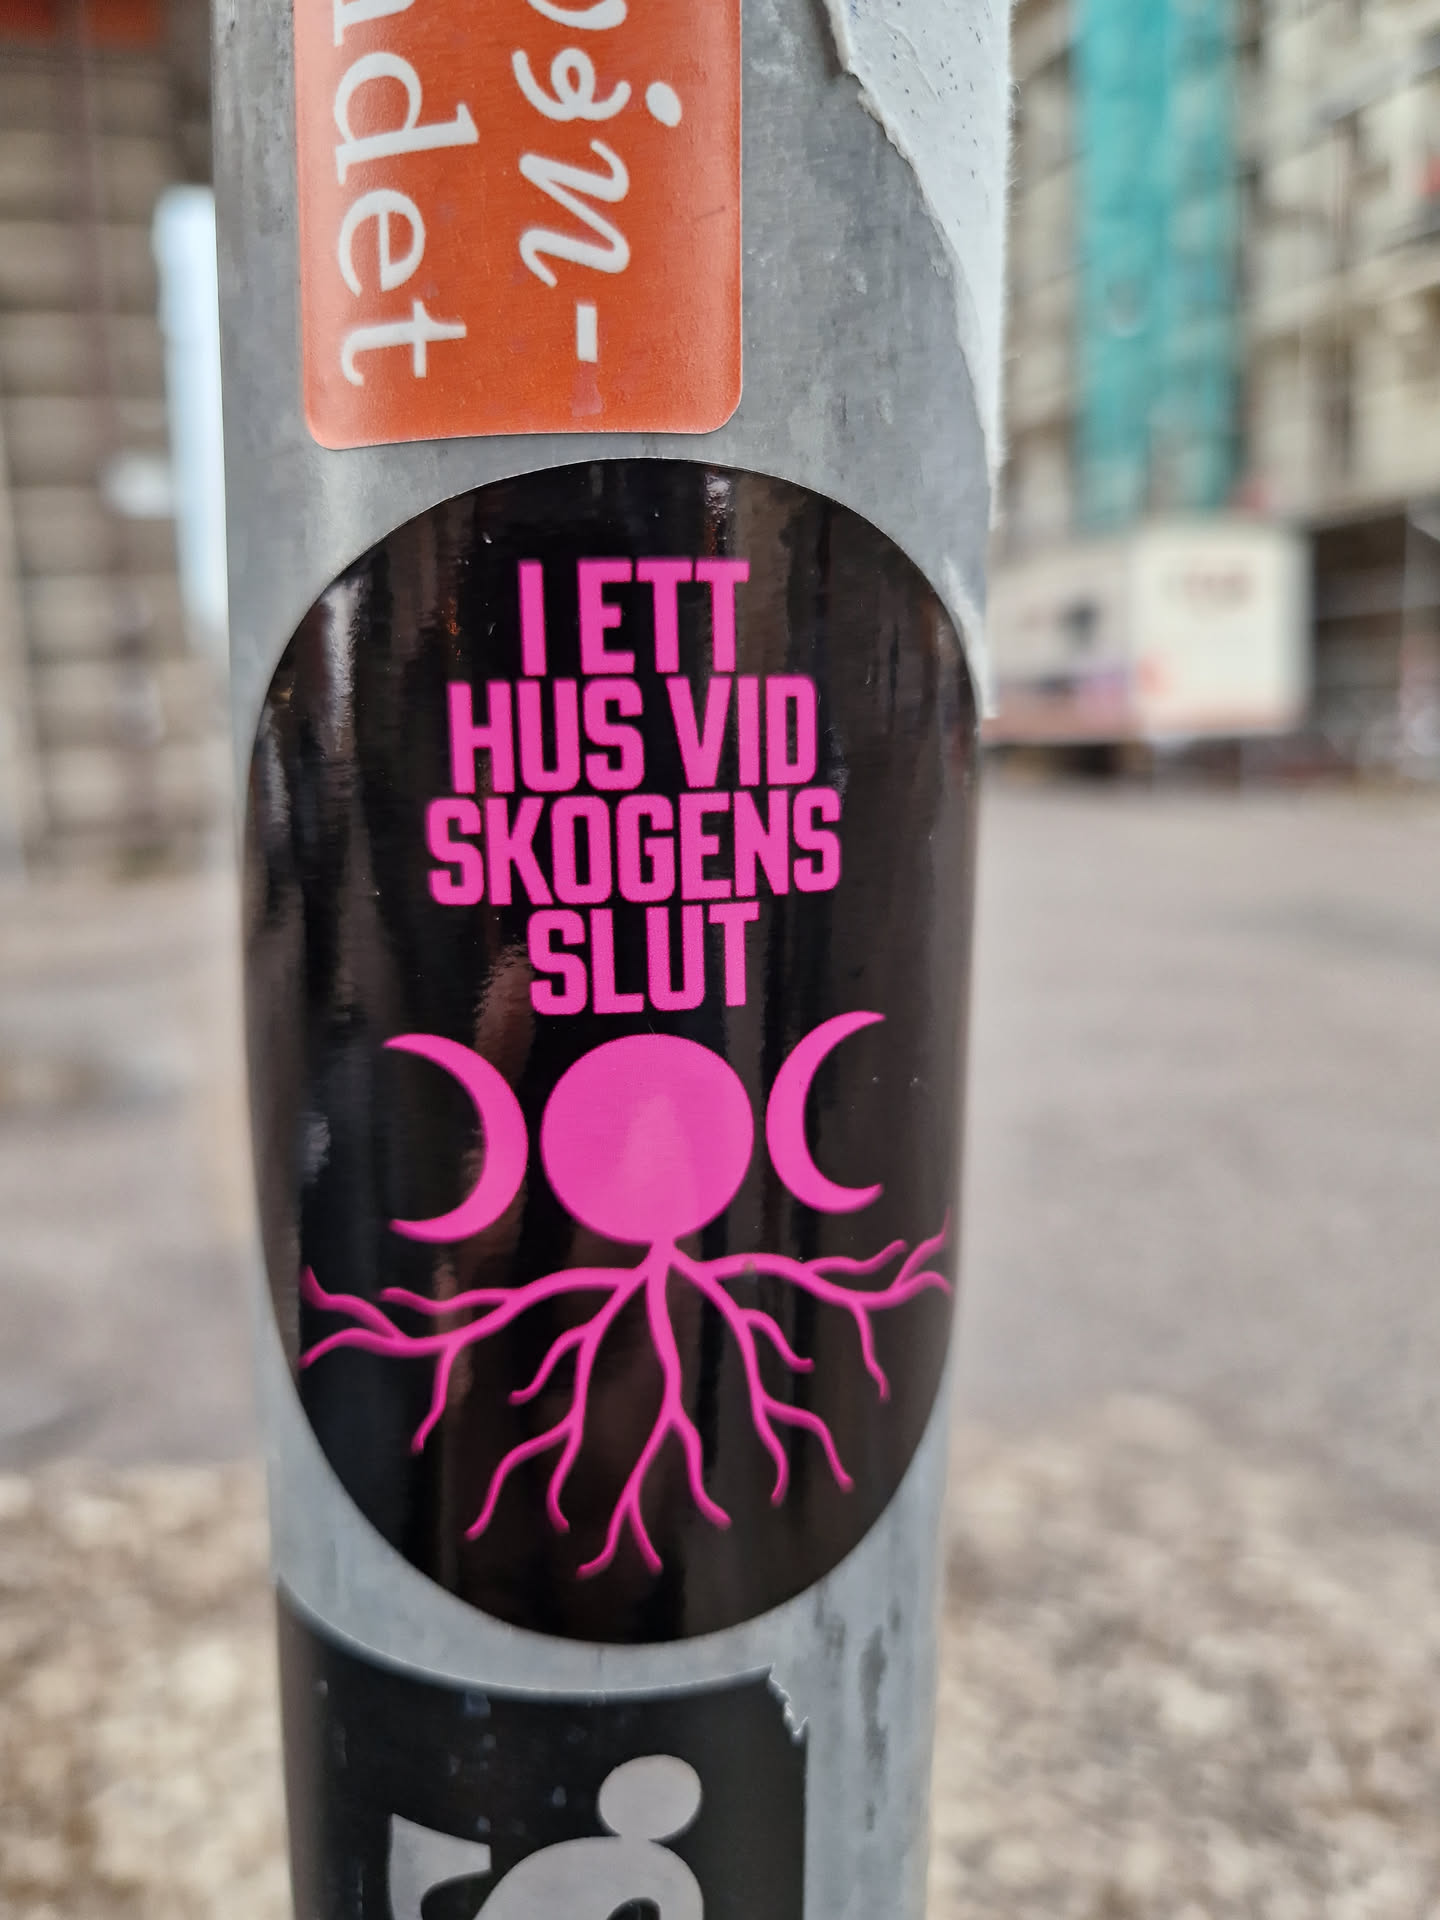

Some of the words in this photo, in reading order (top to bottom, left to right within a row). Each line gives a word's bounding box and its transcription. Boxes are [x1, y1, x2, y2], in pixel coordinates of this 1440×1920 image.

[519, 559, 547, 677] I
[577, 557, 751, 675] ETT
[448, 678, 645, 794] HUS
[666, 674, 818, 789] VID
[426, 787, 842, 906] SKOGENS
[527, 902, 760, 1015] SLUT
